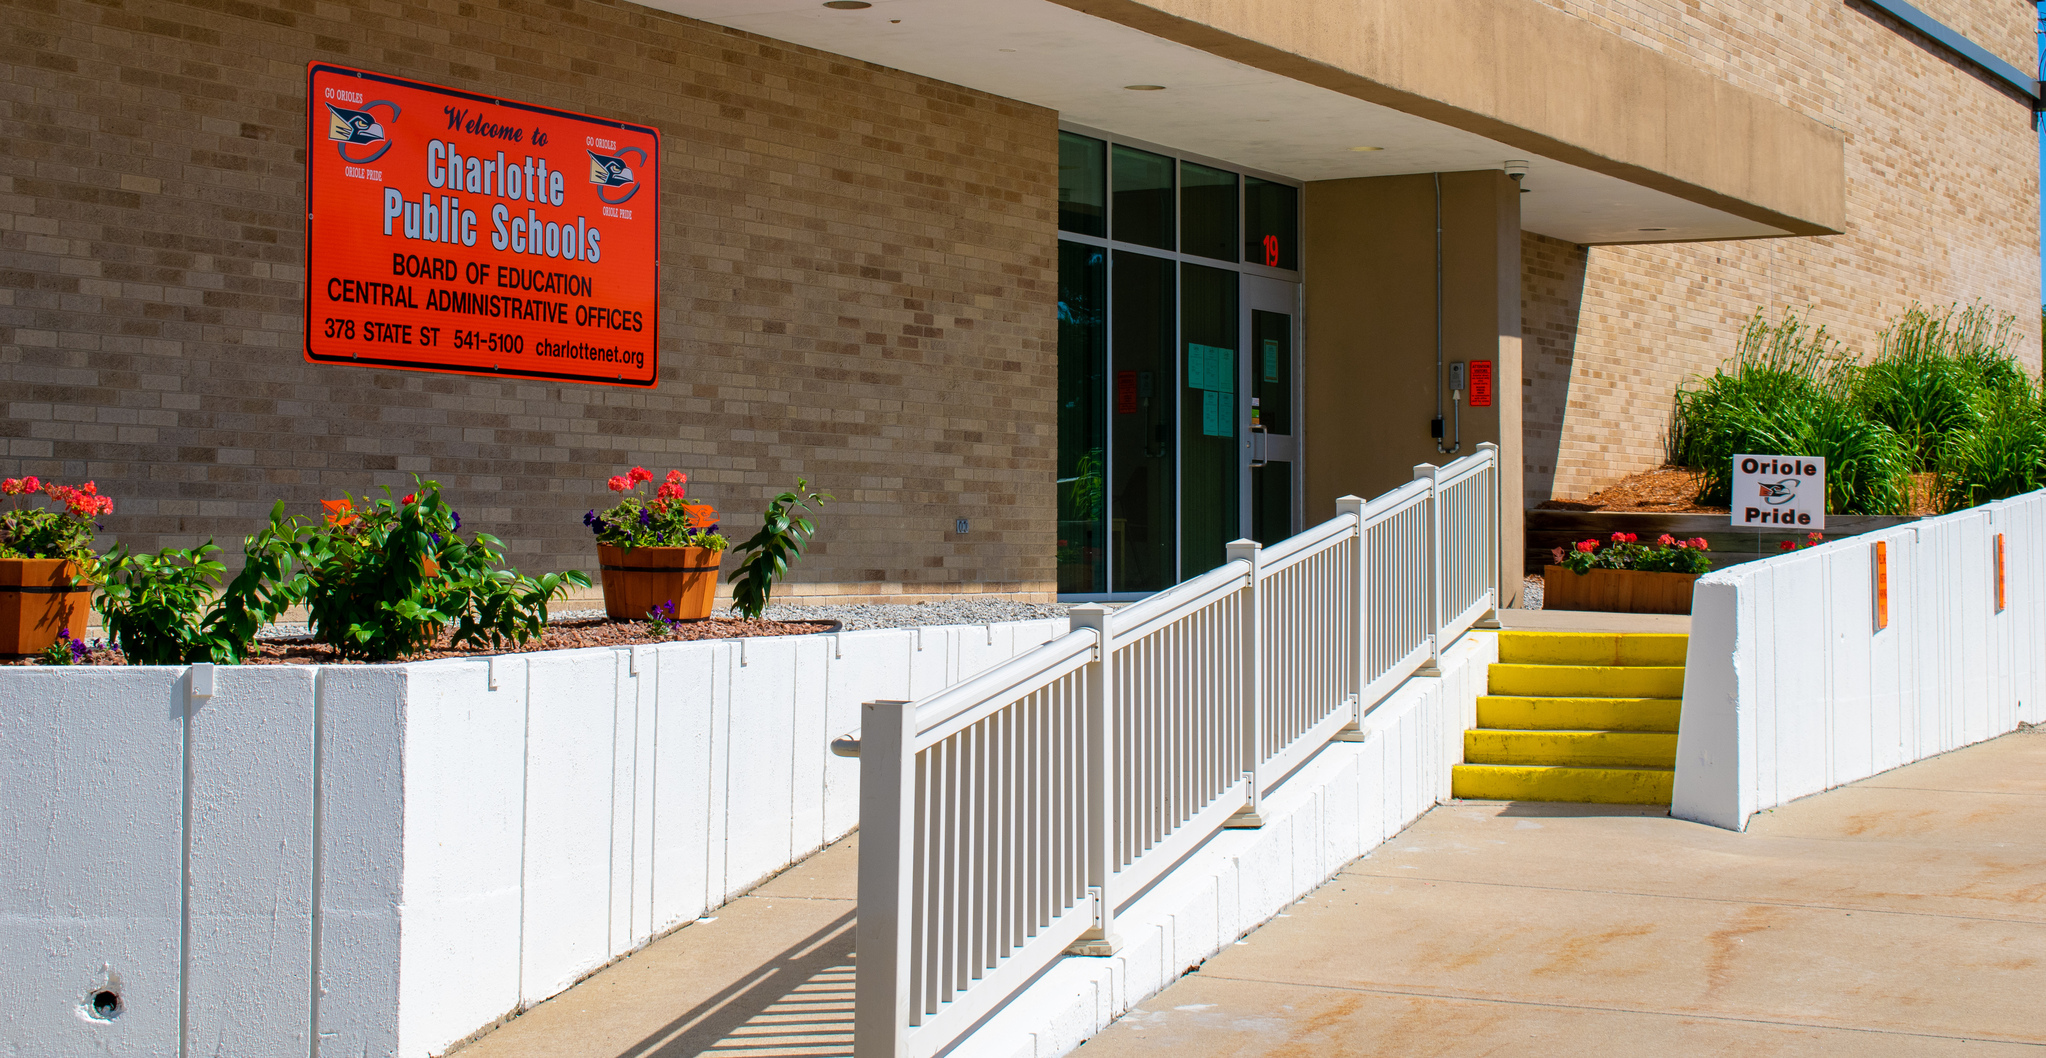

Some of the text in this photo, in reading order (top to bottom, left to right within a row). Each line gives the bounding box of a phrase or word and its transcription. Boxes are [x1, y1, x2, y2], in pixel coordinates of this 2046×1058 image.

[325, 87, 363, 104] GO ORIOLES
[444, 104, 549, 147] Welcome to
[586, 135, 616, 151] GO ORIOLES
[344, 166, 383, 182] ORIOLE PRIDE
[427, 139, 565, 207] Charlotte
[383, 186, 601, 264] Public Schools
[602, 206, 633, 220] ORIOLE PRIDE
[1263, 234, 1279, 267] 19
[392, 253, 592, 298] BOARD OF EDUCATION
[327, 277, 643, 333] CENTRAL ADMINISTRATIVE OFFICES
[324, 317, 644, 369] 378 STATE ST 541-5100 charlottenet.org
[1741, 457, 1817, 476] Oriole
[1744, 506, 1811, 525] Pride
